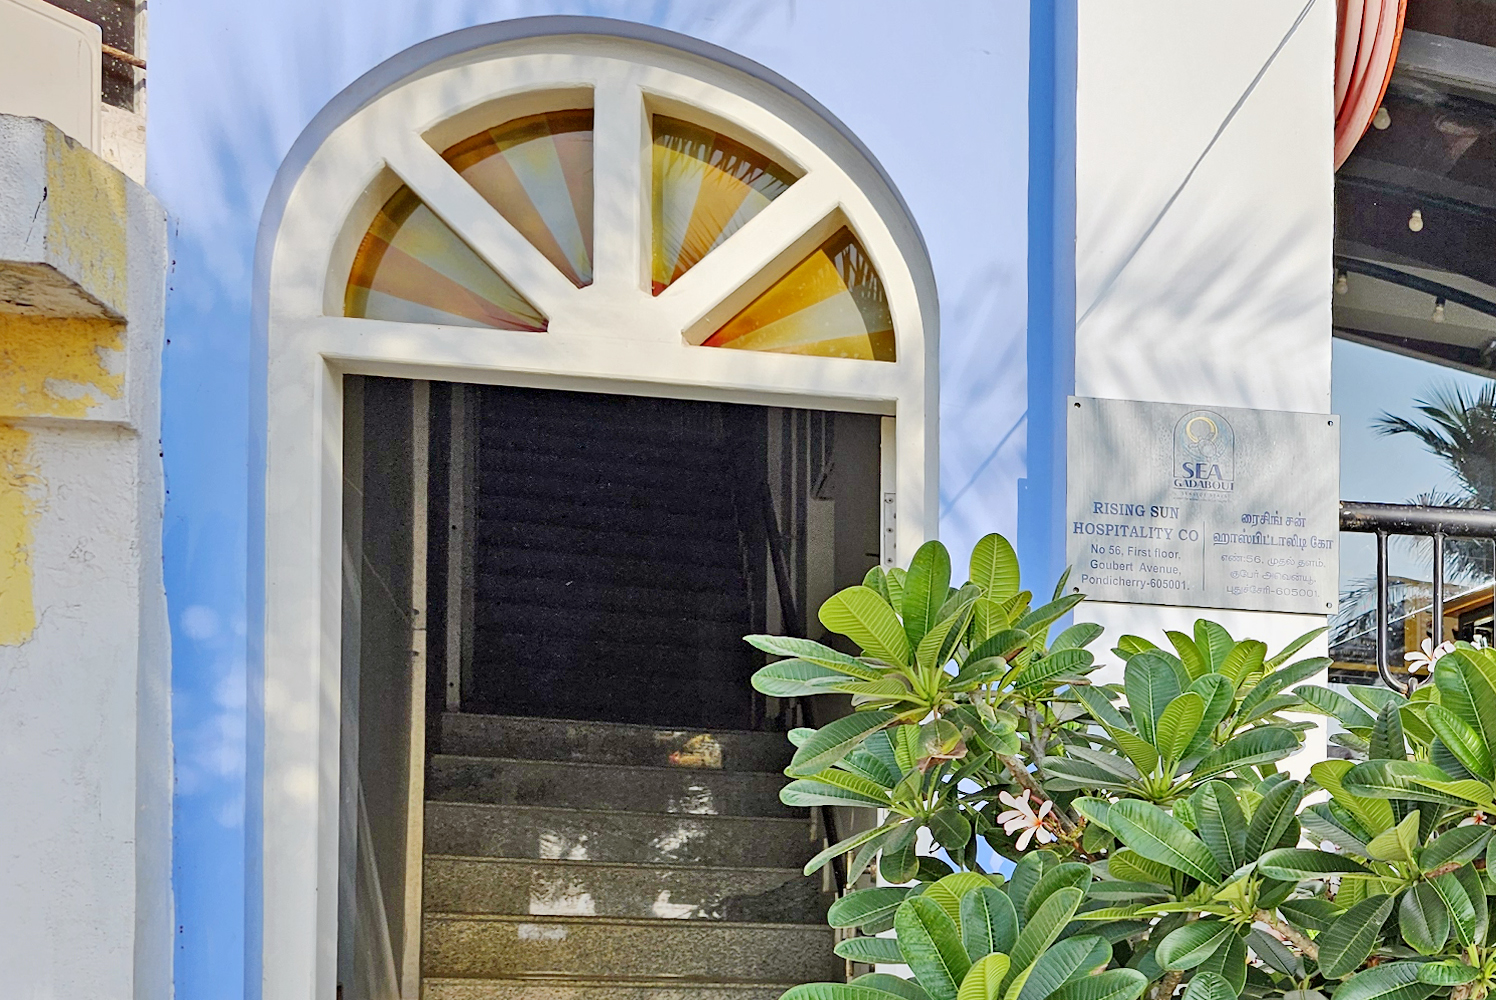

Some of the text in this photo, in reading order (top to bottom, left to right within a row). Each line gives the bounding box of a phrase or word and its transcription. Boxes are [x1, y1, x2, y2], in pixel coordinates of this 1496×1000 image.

[1182, 461, 1222, 480] SEA
[1174, 479, 1234, 490] GADABOUT
[1093, 502, 1180, 519] RISING SUN
[1285, 512, 1307, 528] சன்
[1073, 521, 1199, 541] HOSPITALITY CO
[1090, 544, 1106, 554] No
[1109, 545, 1124, 557] 56,
[1127, 546, 1151, 558] First
[1310, 535, 1334, 550] கோ
[1090, 559, 1182, 576] Goubert Avenue,
[1081, 574, 1190, 591] Pondicherry-605001.
